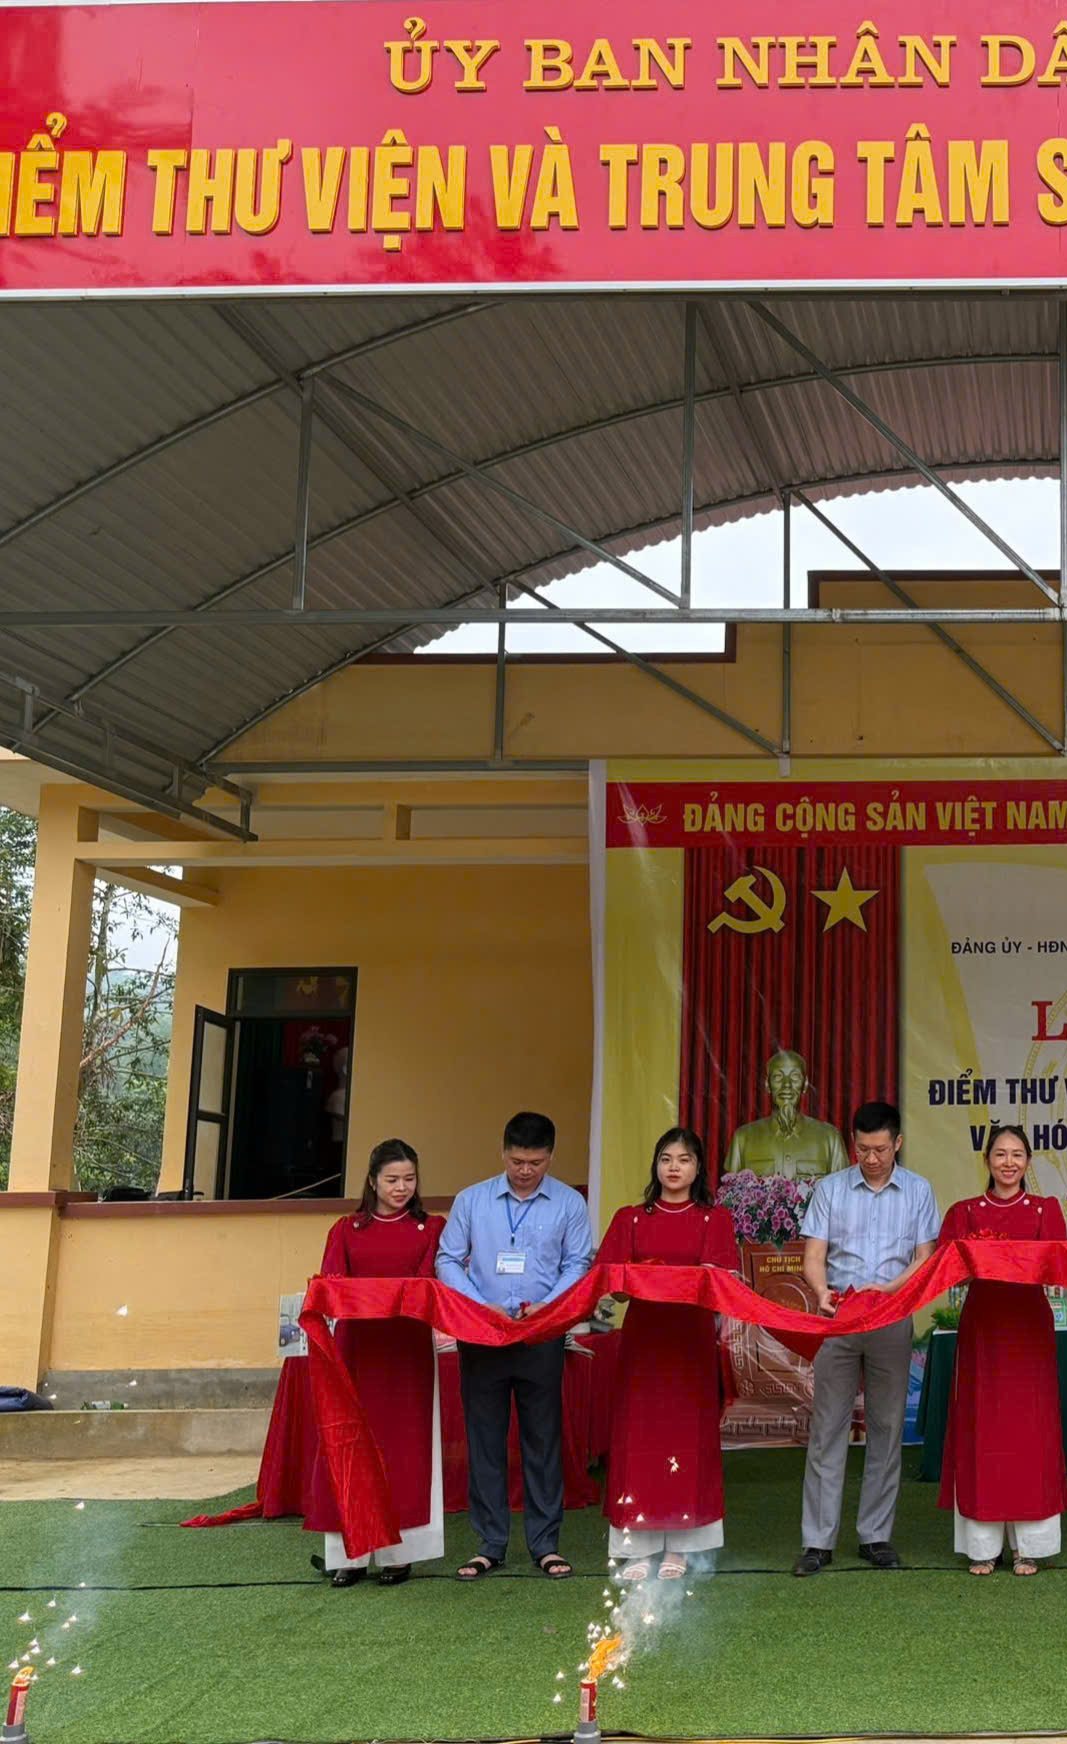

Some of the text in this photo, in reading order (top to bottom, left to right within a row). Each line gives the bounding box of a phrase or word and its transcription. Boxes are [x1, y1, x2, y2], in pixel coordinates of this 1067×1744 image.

[386, 18, 498, 92] ỦY
[523, 38, 692, 89] BAN
[716, 21, 957, 87] NHÂN
[0, 111, 126, 235] IỂM
[147, 139, 292, 234] THƯ
[302, 129, 467, 250] VIỆN
[489, 125, 579, 230] VÀ
[600, 140, 835, 228] TRUNG
[856, 123, 1010, 226] TÂM
[683, 791, 765, 832] ĐẢNG
[775, 797, 856, 838] CỘNG
[866, 790, 926, 831] SẢN
[936, 796, 997, 837] VIỆT
[951, 937, 996, 954] ĐẢNG
[1002, 937, 1022, 953] ỦY
[928, 1067, 997, 1106] ĐIỂM
[1005, 1075, 1059, 1105] THƯ
